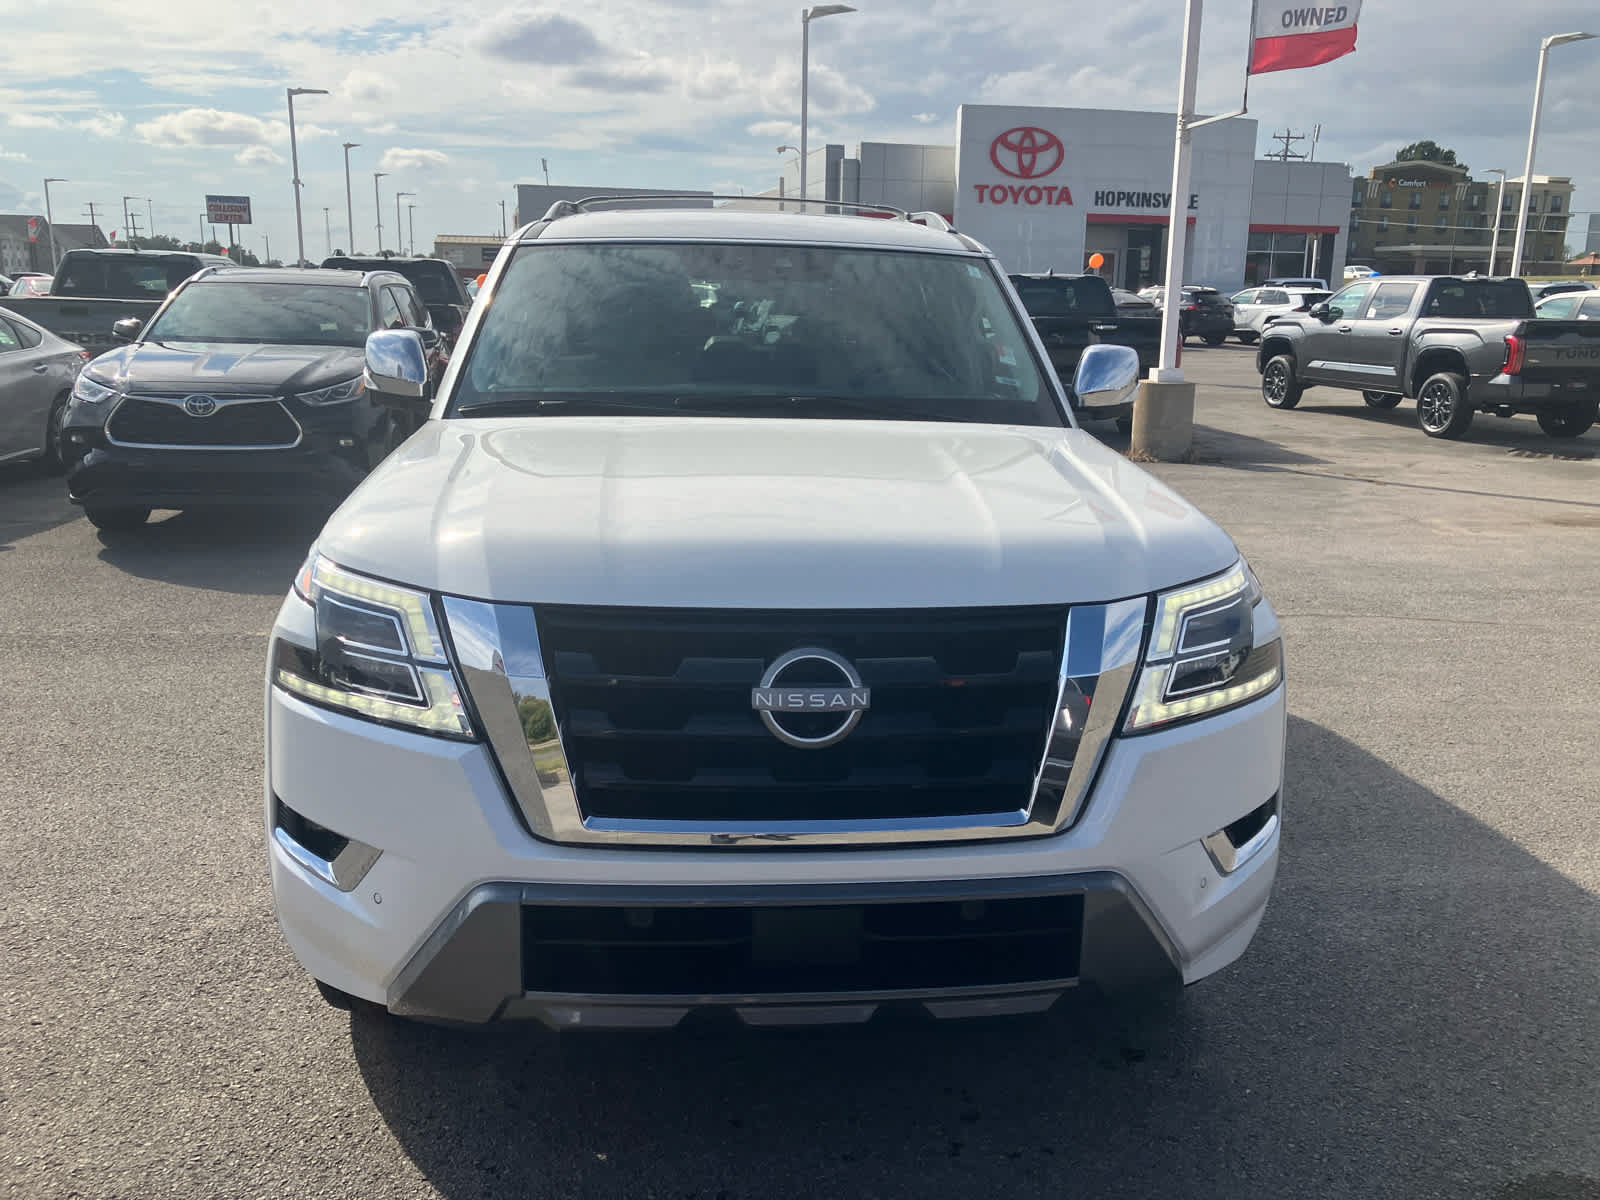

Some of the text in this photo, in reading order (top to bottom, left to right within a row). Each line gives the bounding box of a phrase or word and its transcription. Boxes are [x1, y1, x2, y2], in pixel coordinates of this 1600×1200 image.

[1281, 6, 1348, 28] OWNED
[973, 184, 1074, 207] TOYOTA
[1094, 190, 1199, 210] HOPKINSVE
[755, 692, 868, 708] NISSAN
